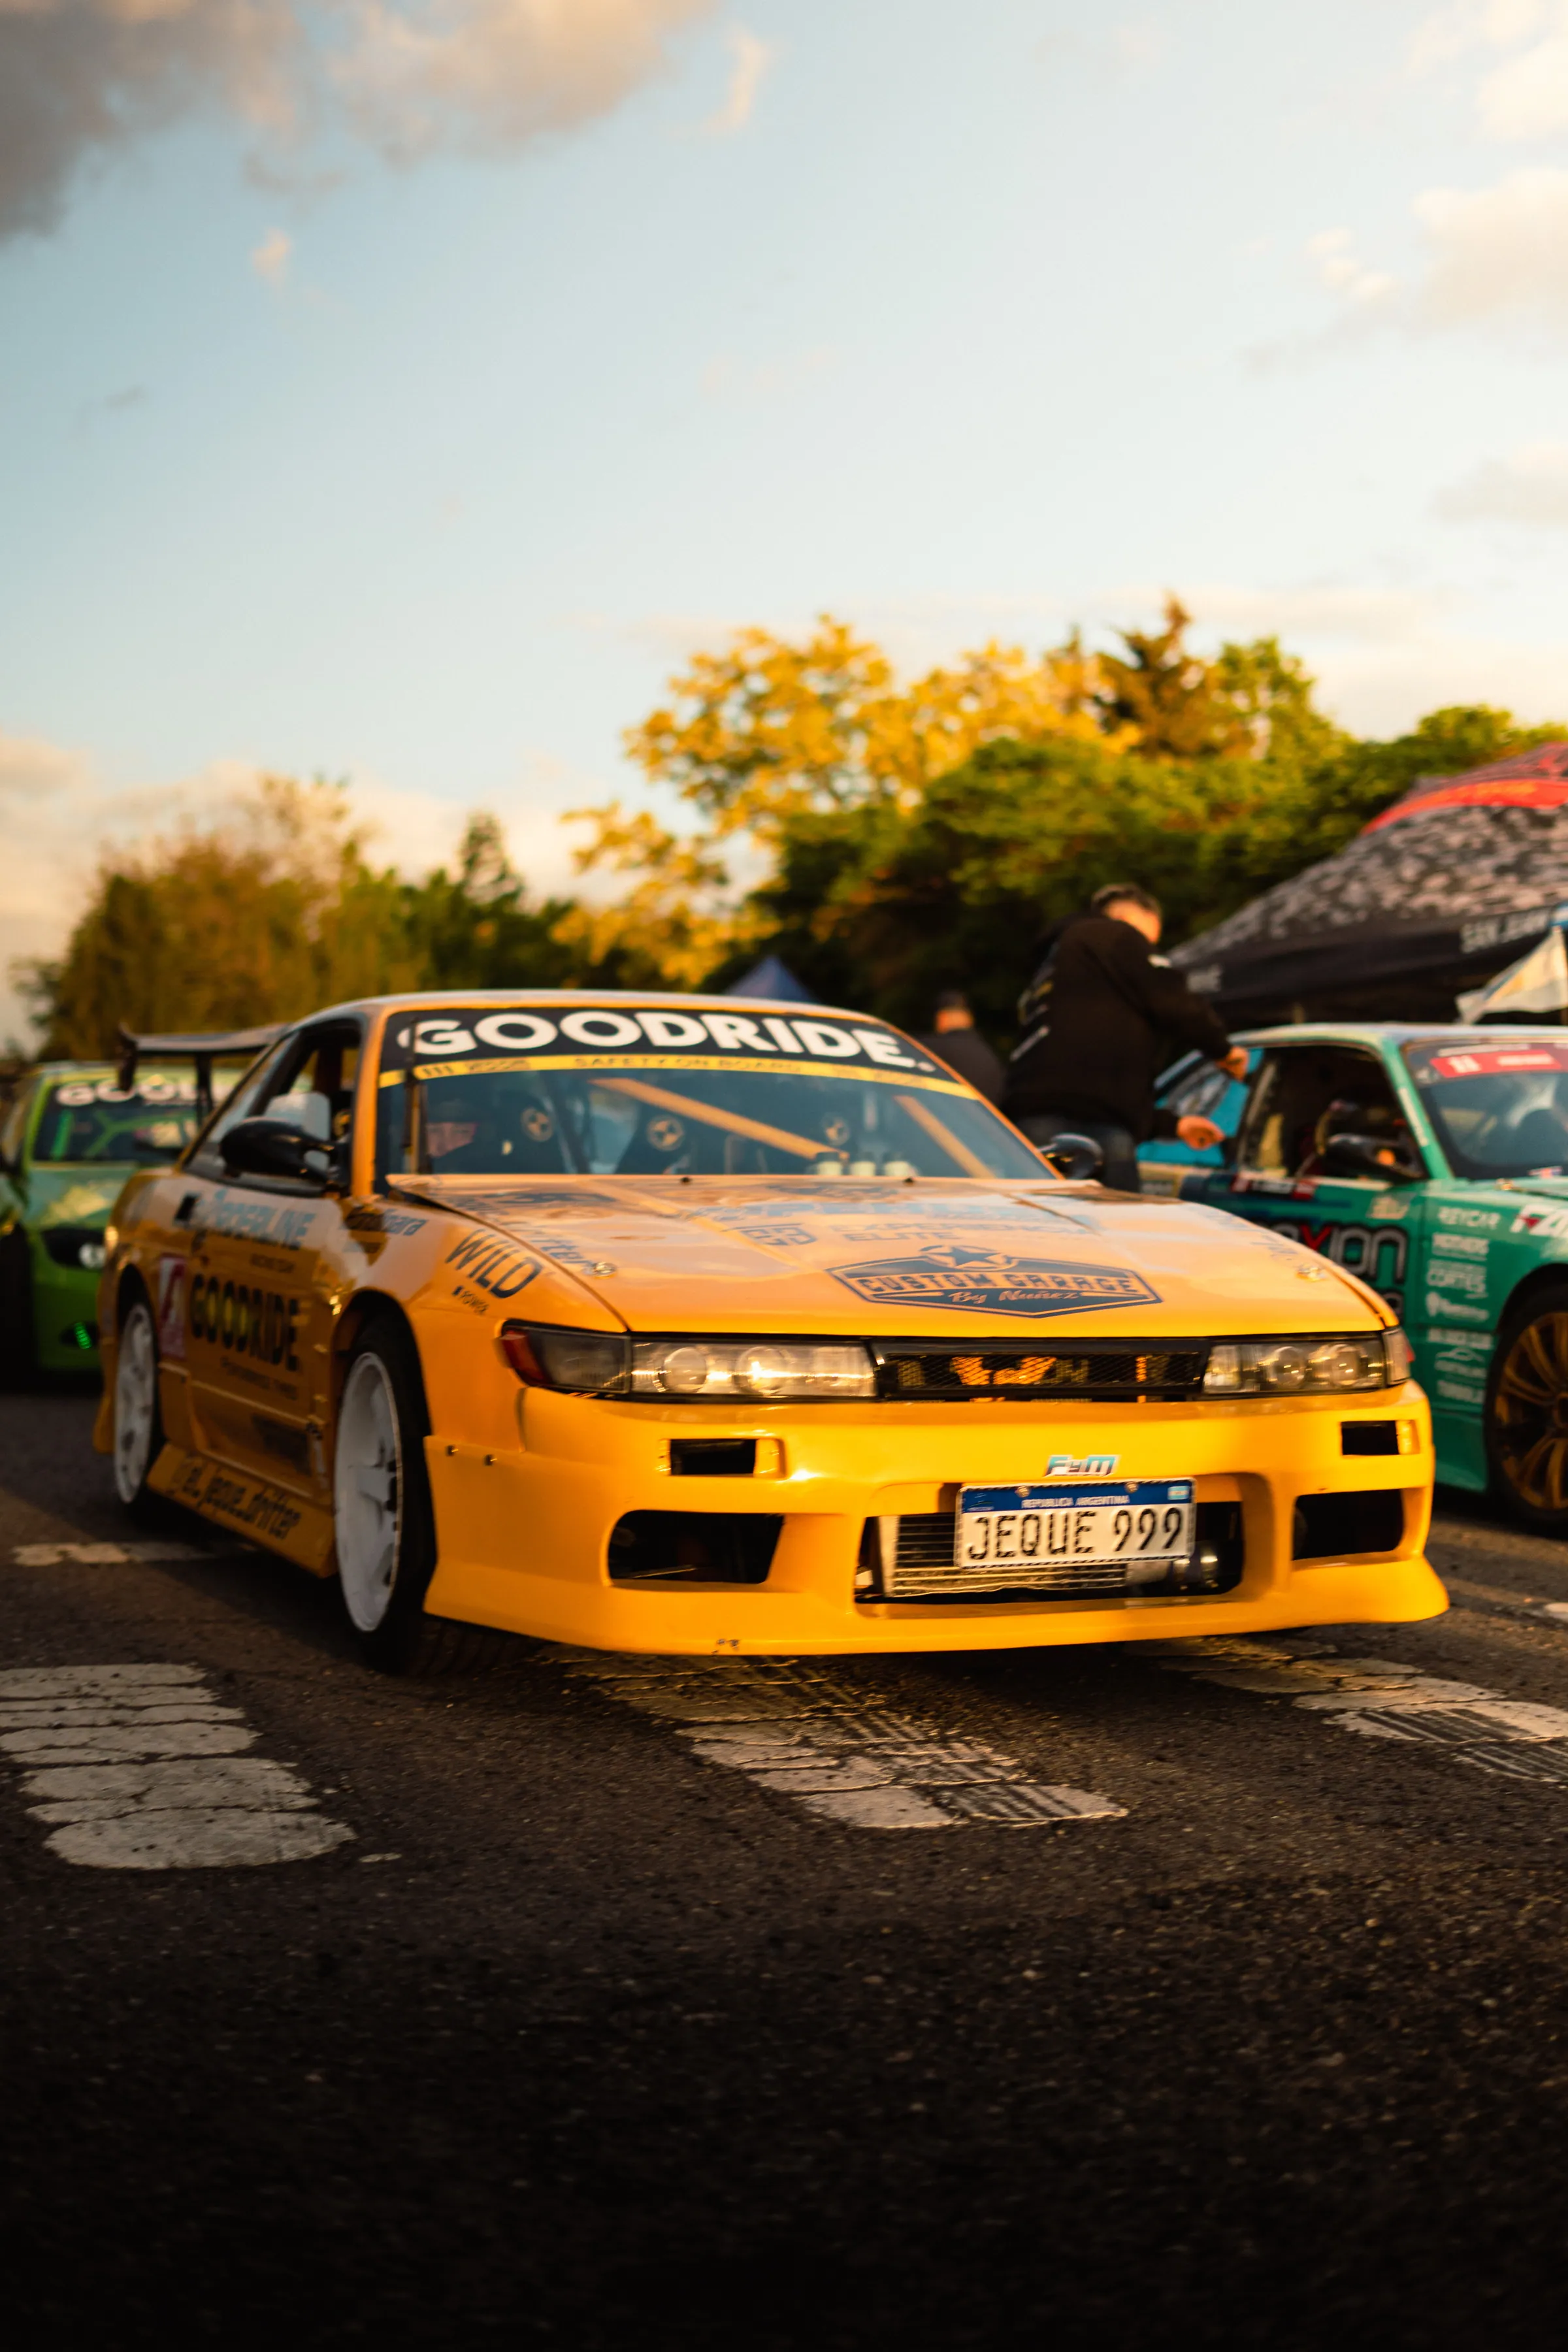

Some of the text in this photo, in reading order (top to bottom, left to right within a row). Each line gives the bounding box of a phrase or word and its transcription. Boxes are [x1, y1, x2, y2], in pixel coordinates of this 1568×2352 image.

[843, 1231, 962, 1241] ELITE
[444, 1228, 544, 1299] WILD
[855, 1272, 1139, 1293] CUSTOM GARAGE
[948, 1290, 988, 1304] By
[191, 1273, 304, 1373] GOODRIDE
[1075, 1494, 1130, 1507] ARGENTINA
[968, 1507, 1183, 1560] JEQUE 999
